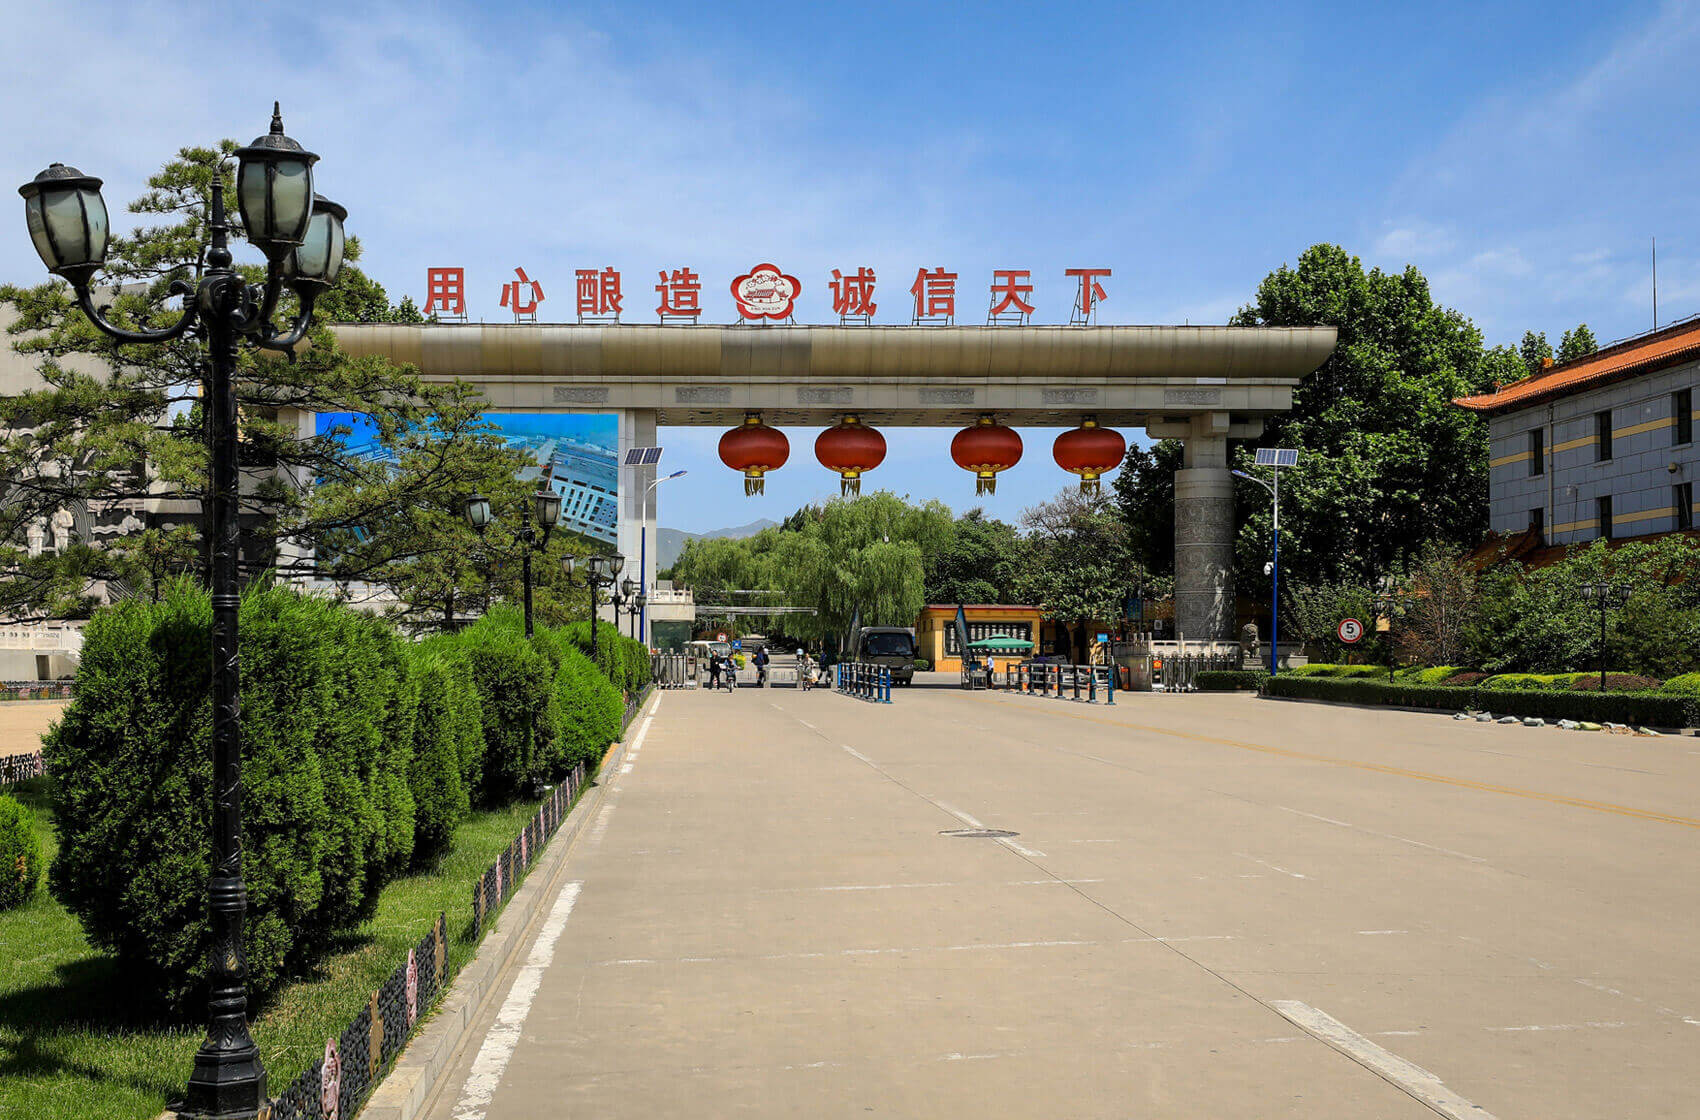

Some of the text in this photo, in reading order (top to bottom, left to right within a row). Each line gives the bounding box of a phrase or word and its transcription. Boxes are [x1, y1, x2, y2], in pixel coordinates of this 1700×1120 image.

[422, 266, 1112, 317] 用心酿造 诚信天下
[1346, 623, 1354, 634] 5
